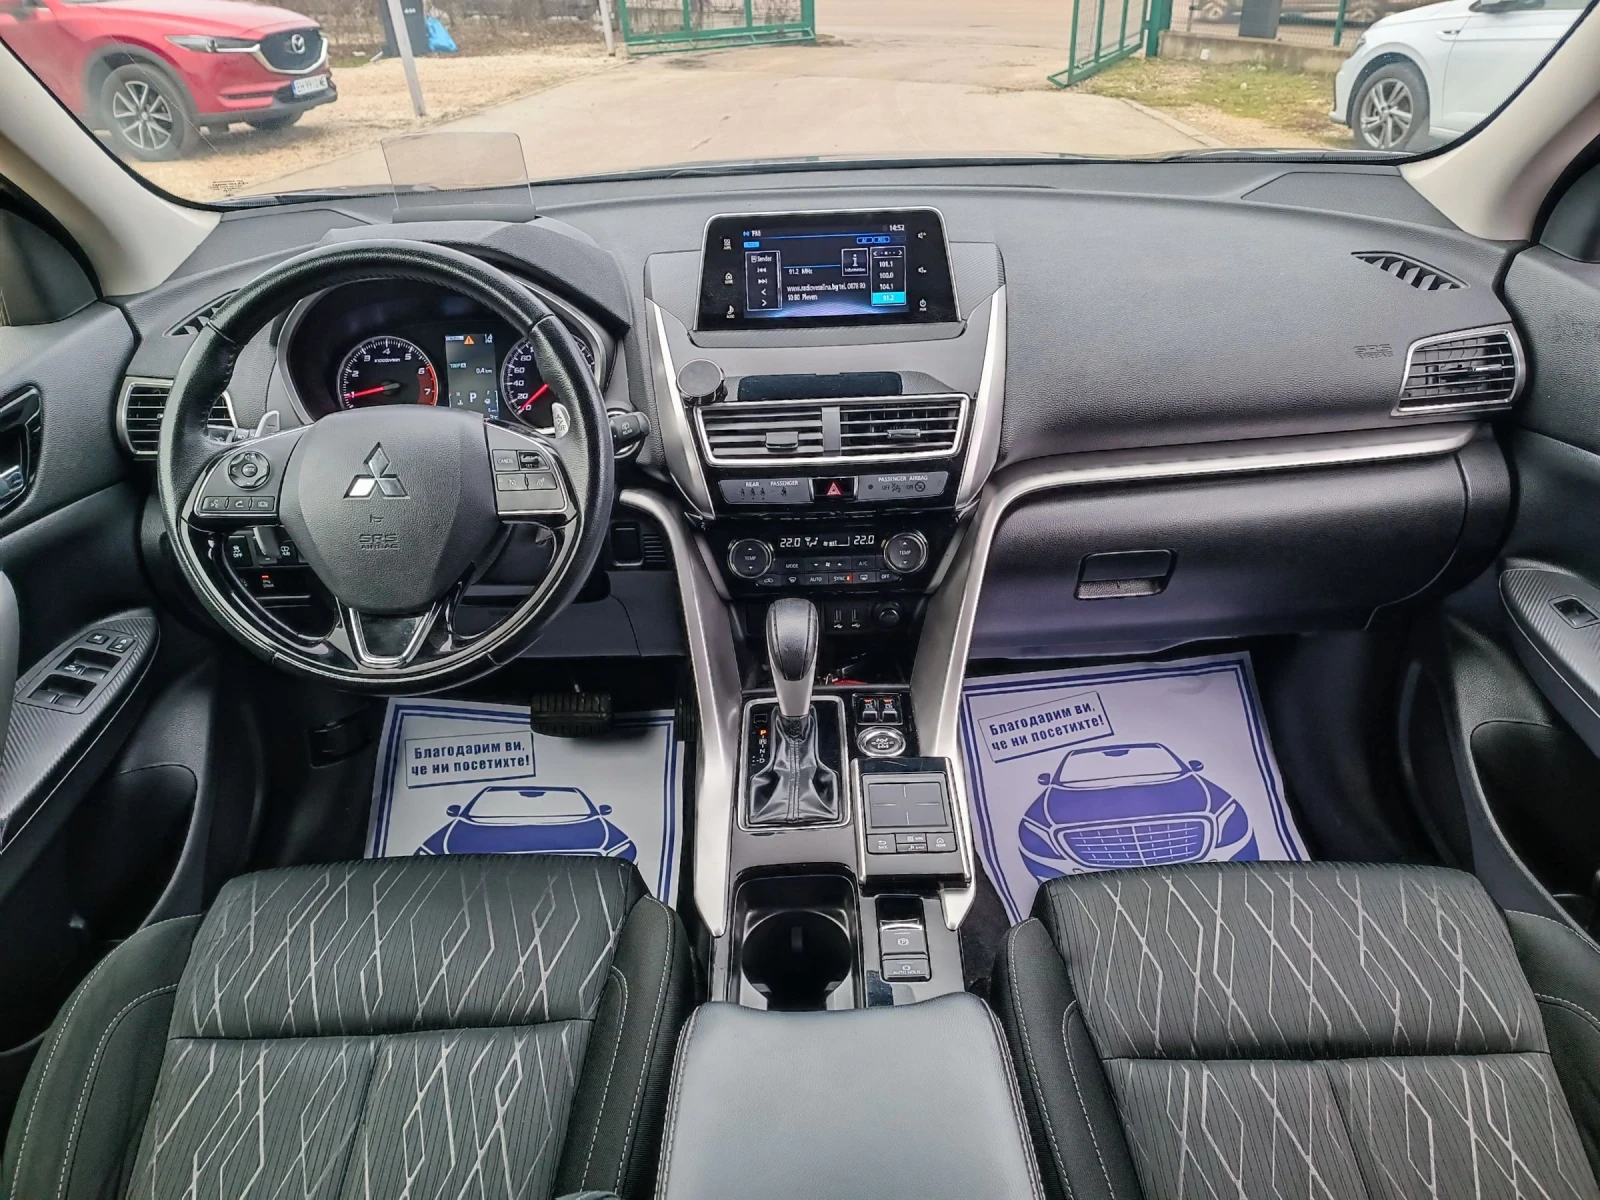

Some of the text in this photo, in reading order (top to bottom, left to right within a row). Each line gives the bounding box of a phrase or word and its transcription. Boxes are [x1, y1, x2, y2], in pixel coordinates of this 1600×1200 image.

[363, 354, 371, 362] 3
[520, 354, 532, 362] 80
[351, 370, 359, 378] 2
[417, 367, 425, 375] 6
[513, 366, 525, 374] 60
[513, 379, 524, 387] 40
[469, 392, 477, 403] P
[779, 537, 801, 548] 22.0
[853, 535, 875, 545] 22.0
[990, 702, 1096, 735] Благодарим ви,
[992, 714, 1105, 751] че ни посетихте!
[414, 742, 501, 759] Благодарим
[411, 755, 530, 776] че ни посетихте!
